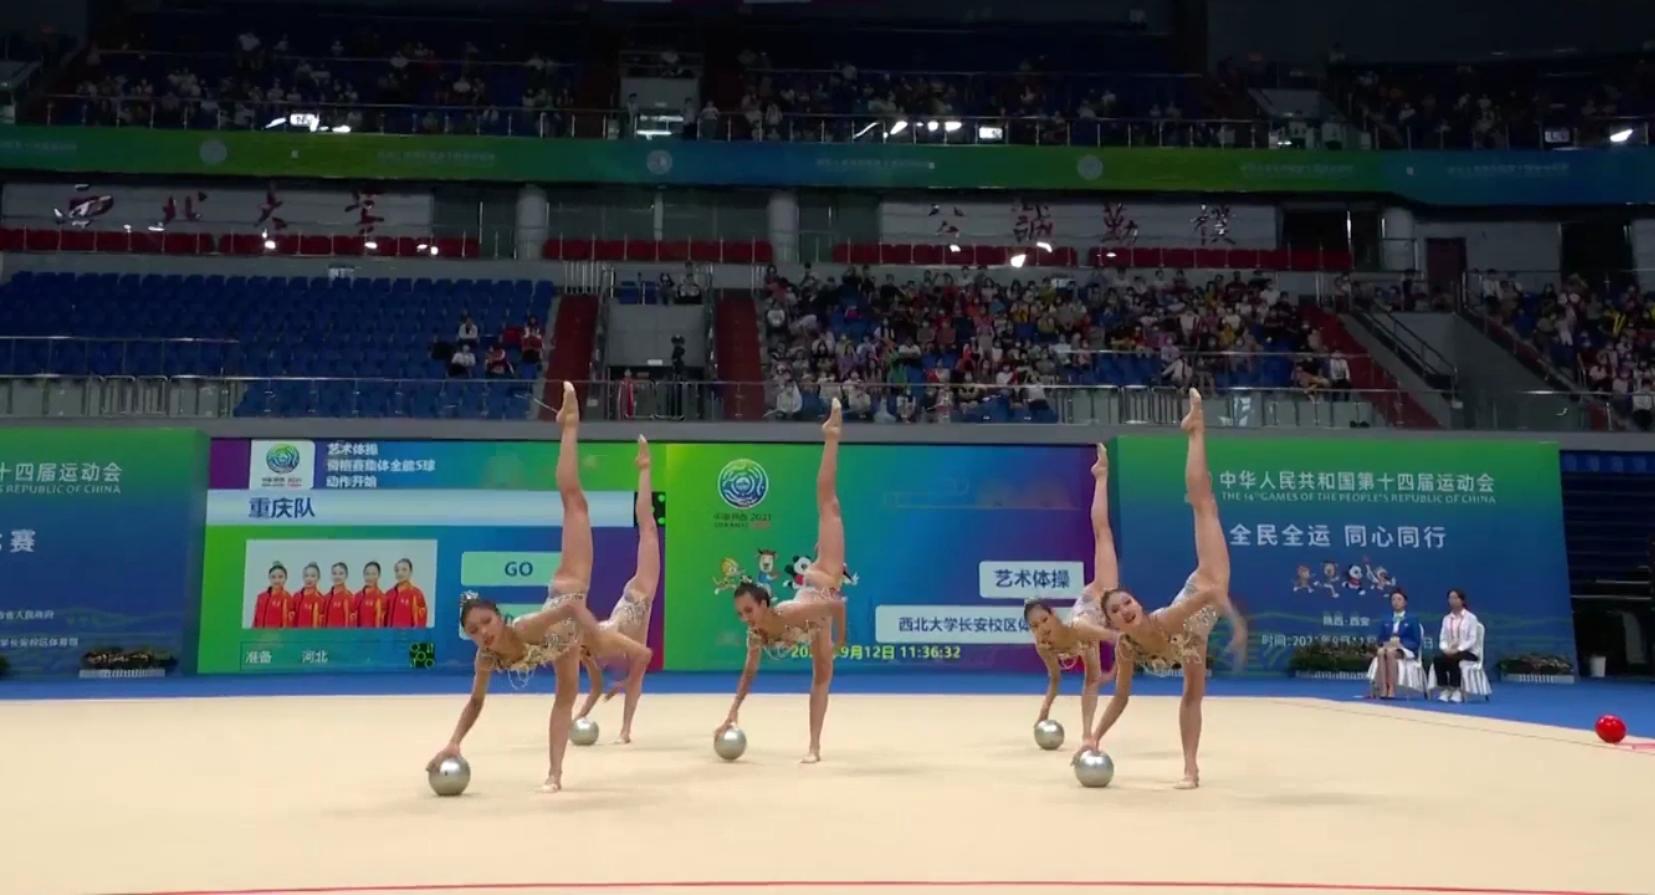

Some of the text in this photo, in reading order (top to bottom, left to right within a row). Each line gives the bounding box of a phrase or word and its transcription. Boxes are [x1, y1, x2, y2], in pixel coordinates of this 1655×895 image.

[328, 443, 378, 456] 艺术体操
[0, 462, 122, 482] 十四届运动会
[66, 484, 80, 494] OF
[84, 484, 121, 494] CHINA
[1219, 470, 1495, 493] 中华人民共和国第十四届运动会
[1222, 491, 1240, 501] THE
[1300, 492, 1313, 502] OF
[1318, 492, 1337, 502] THE
[1445, 494, 1458, 504] OF
[1461, 494, 1496, 505] CHINA
[248, 497, 316, 520] 重庆队
[1229, 523, 1447, 549] 全民全运 同心同行
[504, 561, 534, 577] GO
[994, 569, 1070, 589] 艺术体操
[246, 648, 328, 664] 准备 河北
[791, 645, 961, 660] 209月12日 11:36:32
